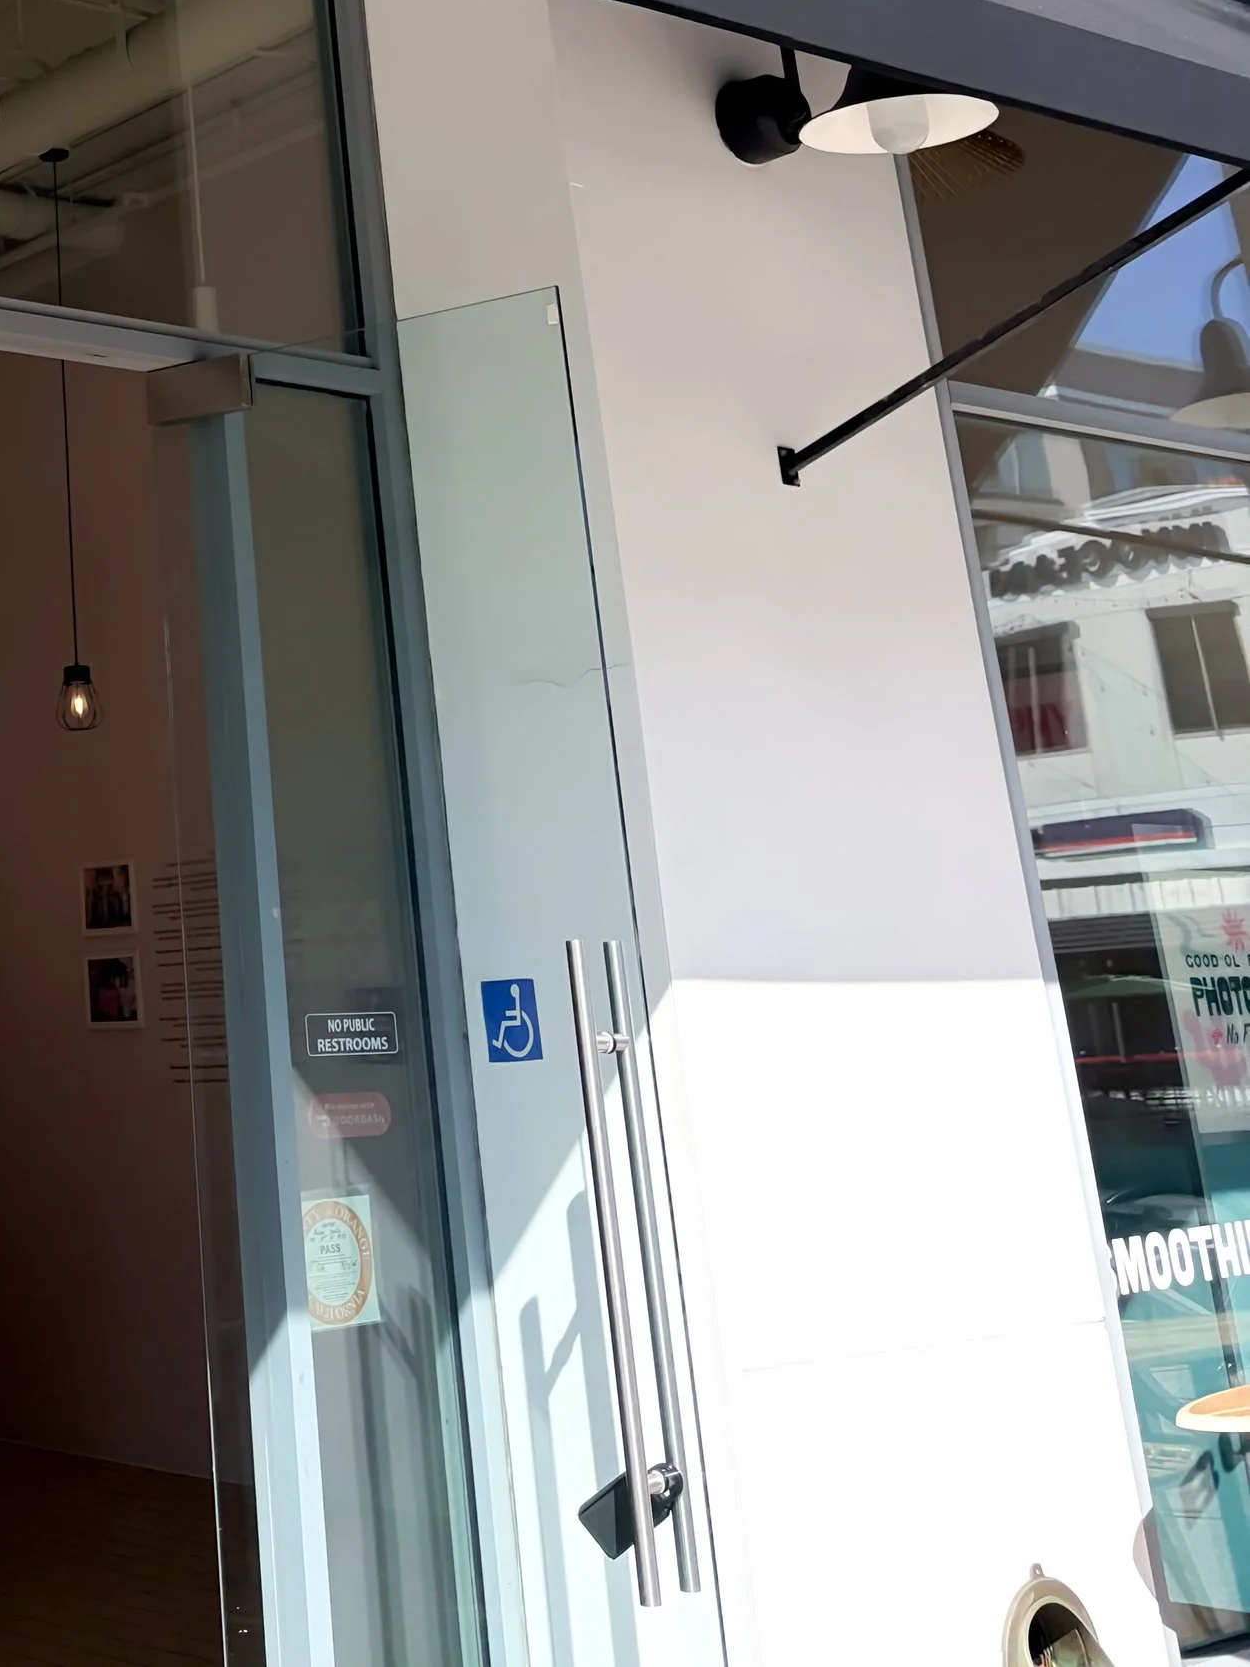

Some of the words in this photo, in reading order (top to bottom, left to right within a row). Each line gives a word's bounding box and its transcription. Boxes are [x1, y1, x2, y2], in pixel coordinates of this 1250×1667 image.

[1185, 954, 1219, 968] GOOD
[1224, 954, 1240, 968] OL
[327, 1018, 342, 1033] NO
[343, 1018, 375, 1032] PUBLIC
[317, 1036, 389, 1053] RESTROOMS
[320, 1243, 341, 1255] PASS
[1108, 1219, 1250, 1296] MOOTHI
